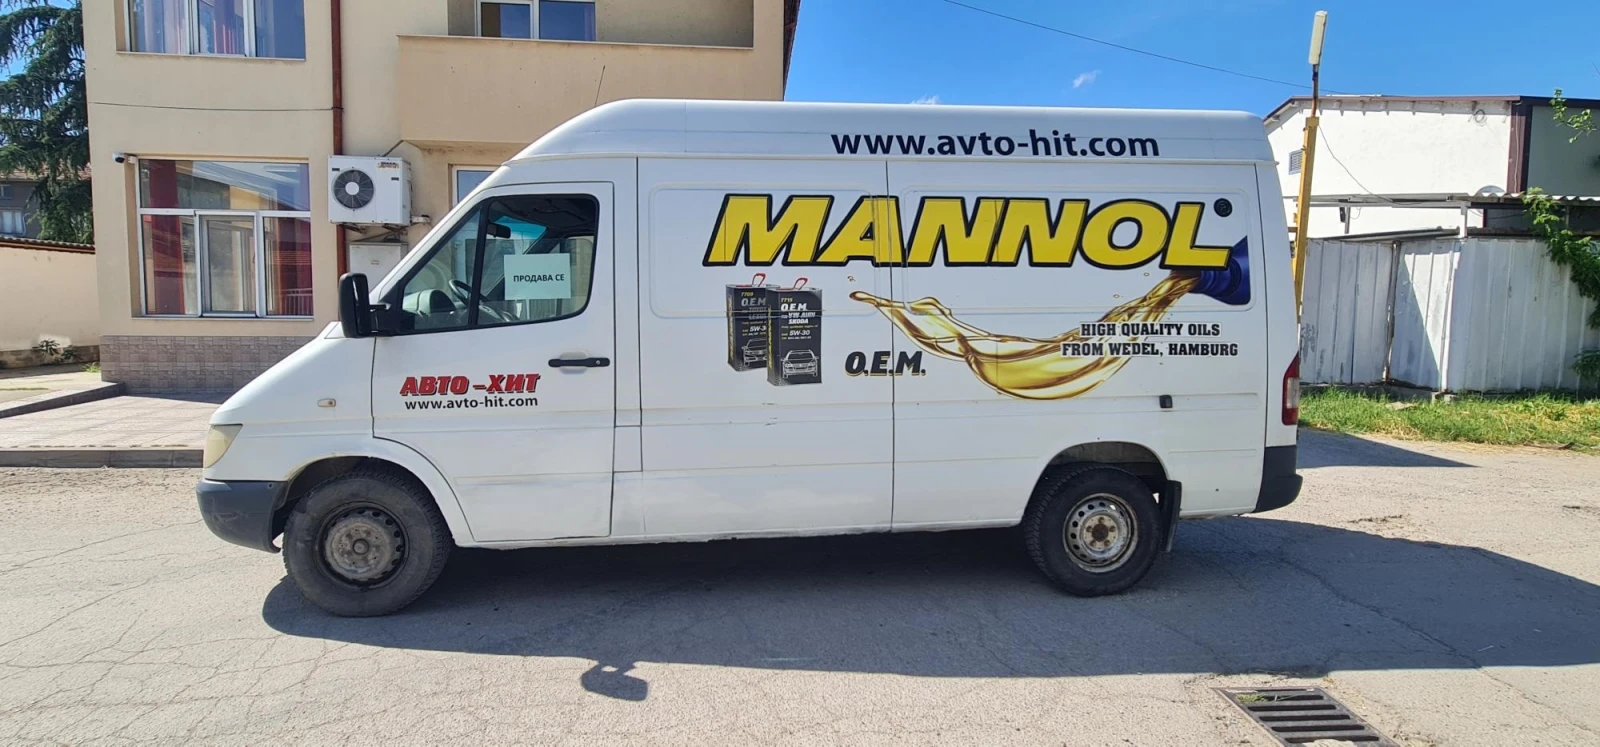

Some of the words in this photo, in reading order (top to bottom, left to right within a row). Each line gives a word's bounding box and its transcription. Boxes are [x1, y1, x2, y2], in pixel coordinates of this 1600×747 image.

[831, 130, 1159, 158] www.avto-hit.com
[703, 194, 1235, 270] MANNOL
[513, 274, 553, 283] ПРОДАВА
[1081, 323, 1117, 336] HIGH
[1121, 323, 1184, 337] QUALITY
[1188, 323, 1221, 336] OILS
[1062, 343, 1104, 356] FROM
[1109, 343, 1164, 357] WEDEL,
[1168, 343, 1239, 356] HAMBURG
[845, 351, 927, 376] O.E.M.
[400, 376, 470, 396] АВТО
[405, 396, 538, 410] www.avto-hit.com
